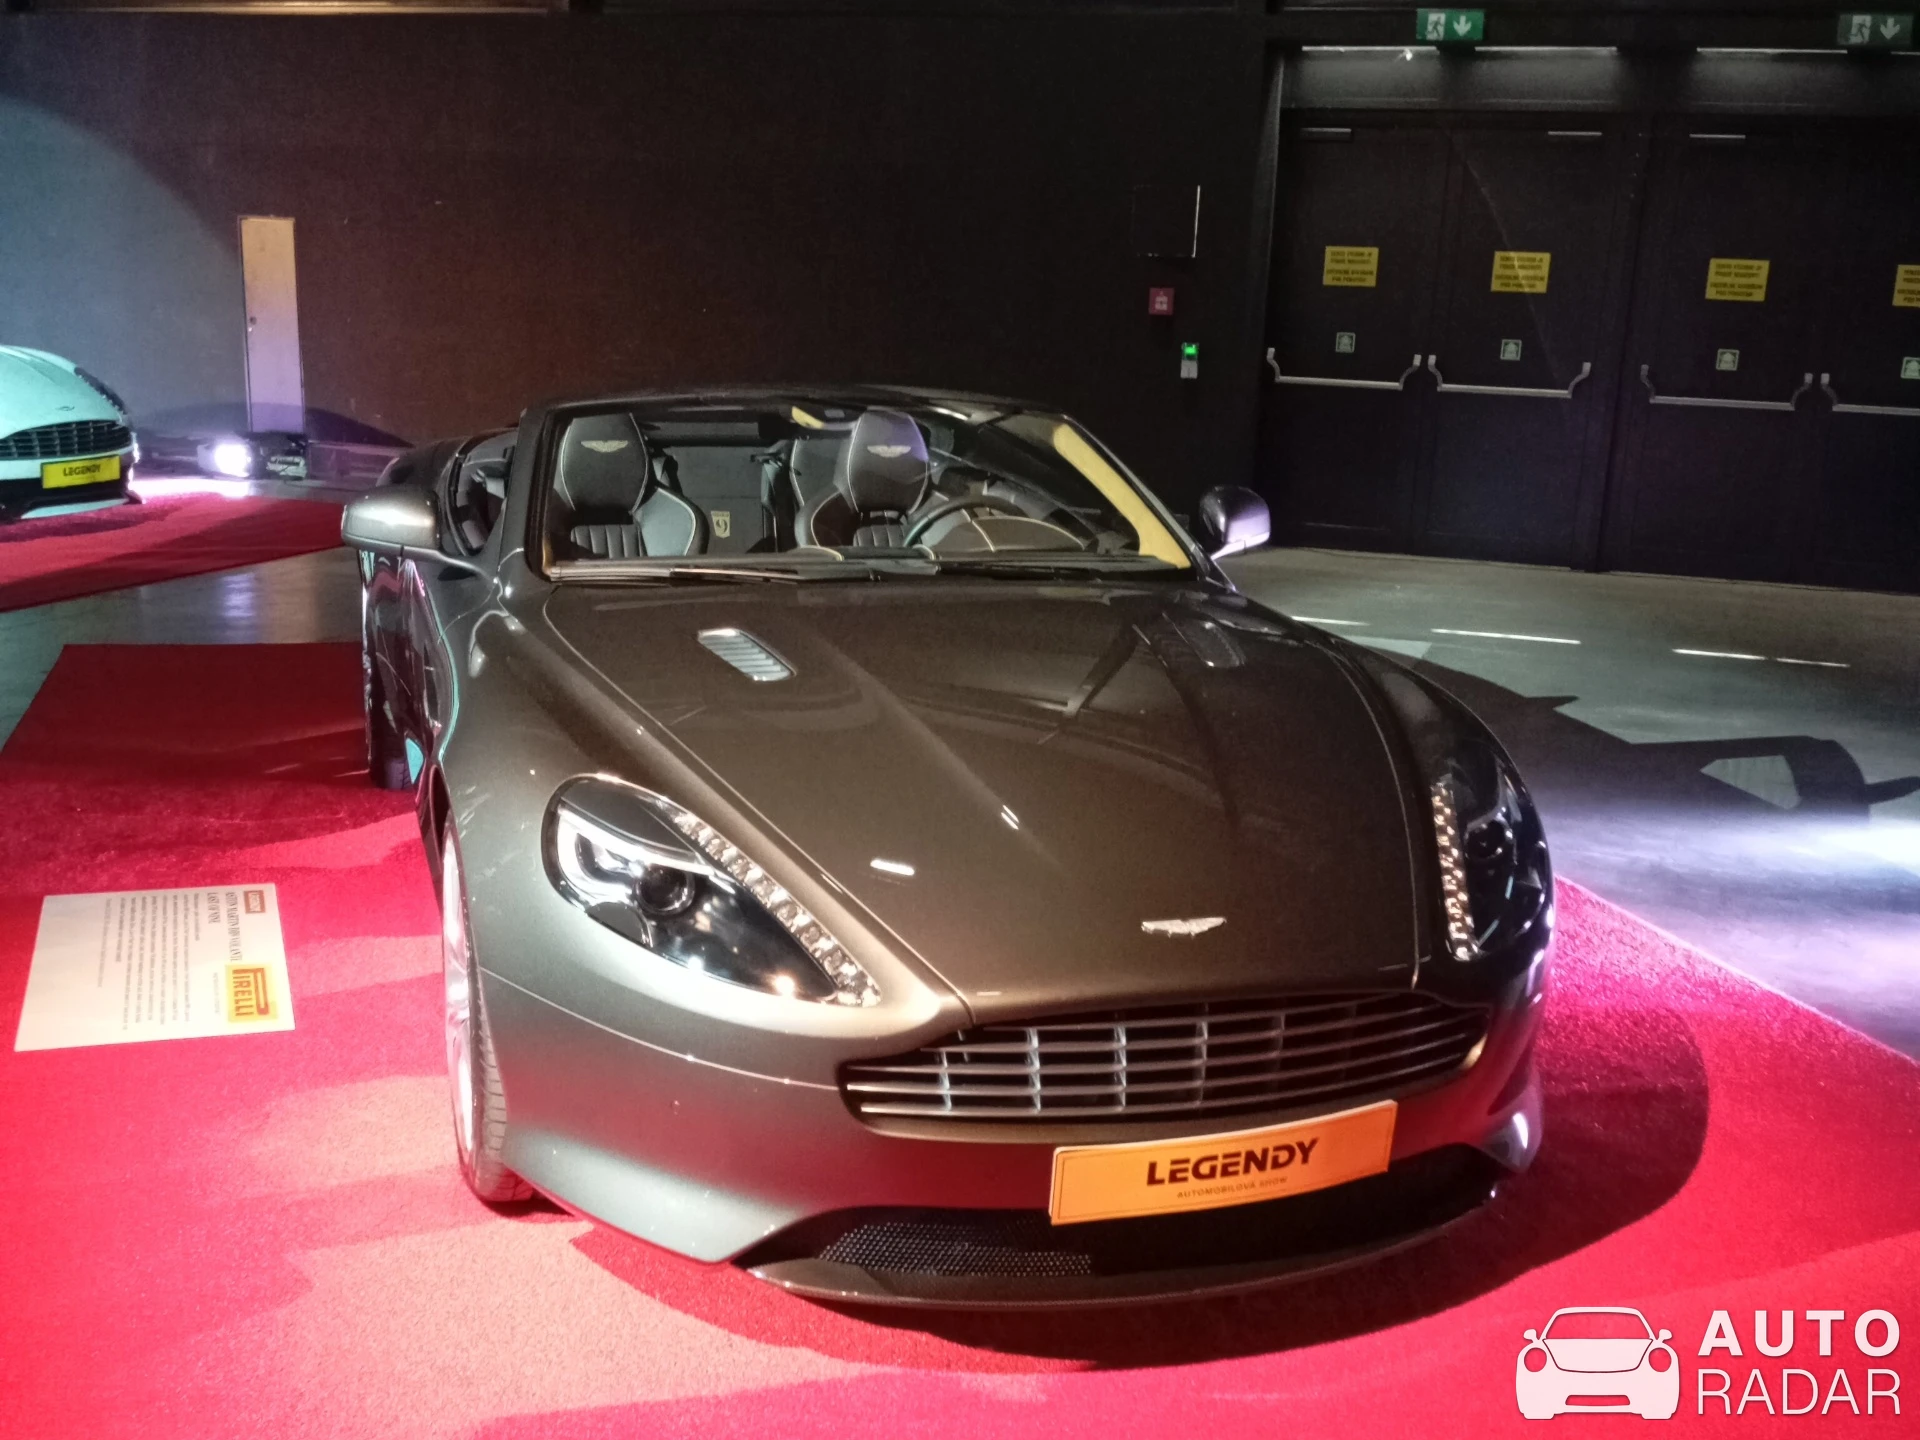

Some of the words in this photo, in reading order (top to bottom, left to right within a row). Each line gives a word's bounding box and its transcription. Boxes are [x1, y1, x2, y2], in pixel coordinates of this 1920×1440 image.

[63, 464, 100, 476] LEGENDY
[232, 968, 270, 1016] PIRELLI
[1147, 1138, 1319, 1186] LEGENDY
[1259, 1175, 1288, 1189] SHOW
